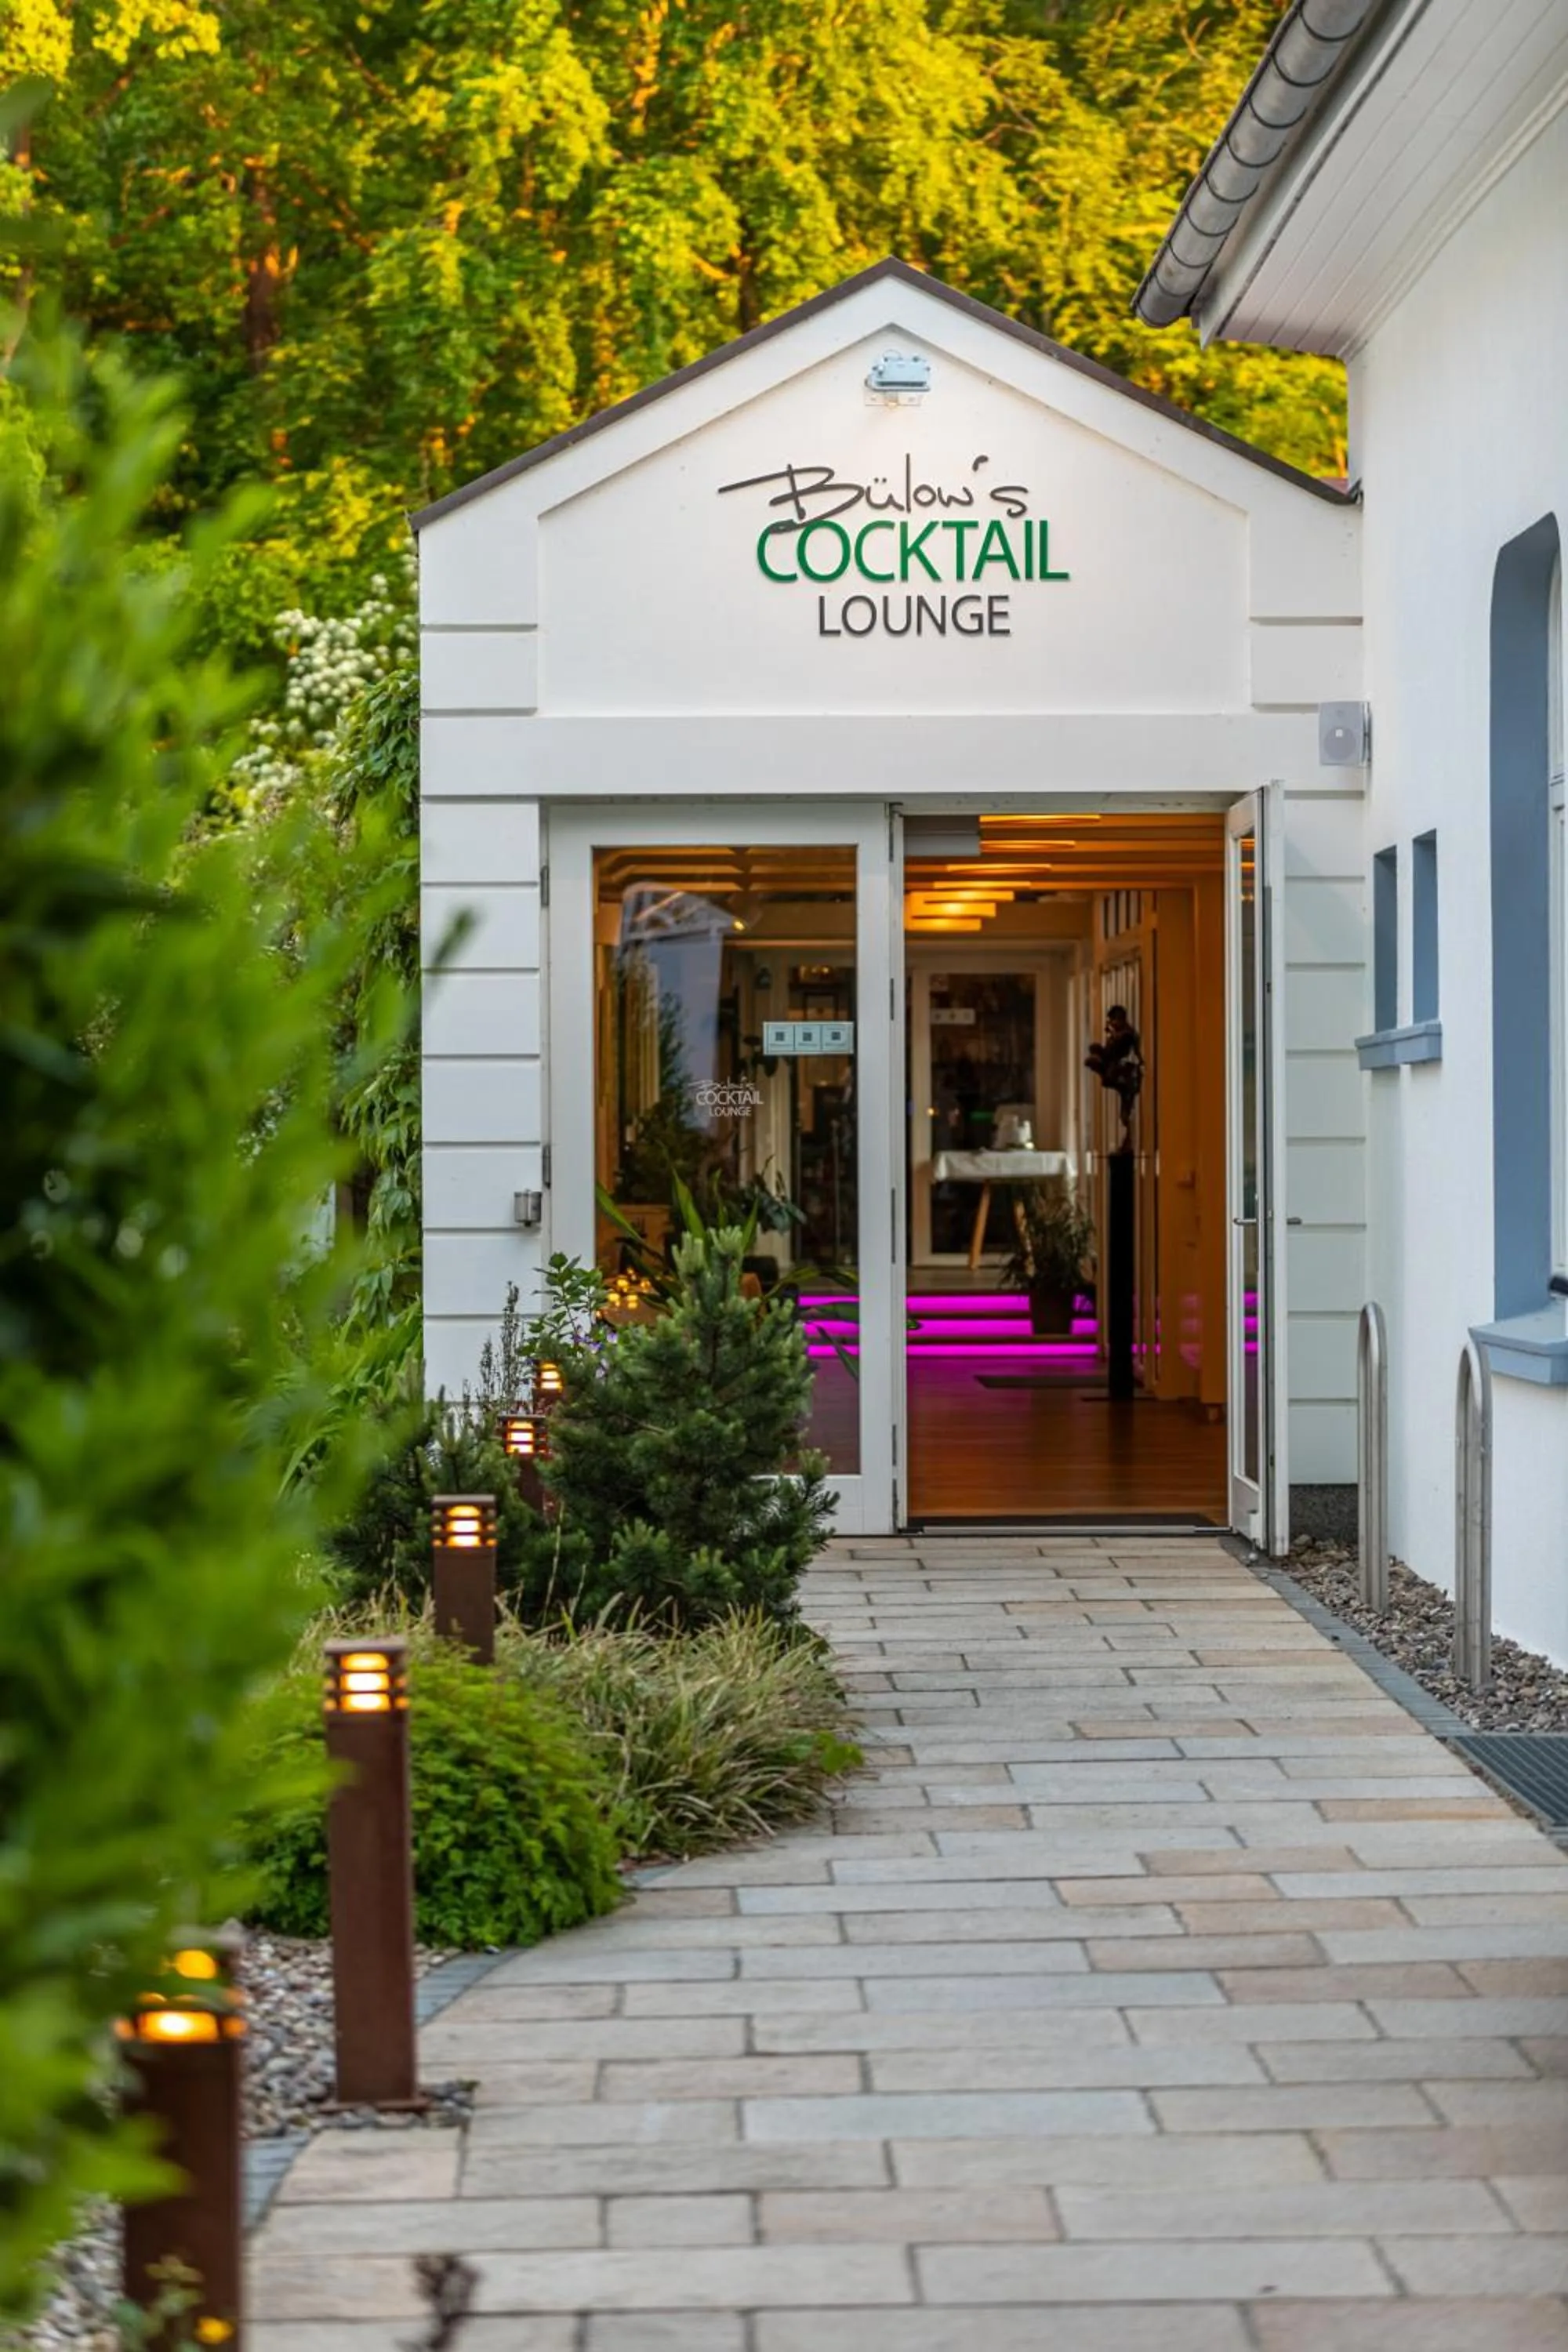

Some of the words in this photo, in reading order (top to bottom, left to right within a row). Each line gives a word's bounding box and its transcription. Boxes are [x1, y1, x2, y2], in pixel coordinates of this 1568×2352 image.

[757, 519, 1069, 583] COCKTAIL
[818, 594, 1011, 637] LOUNGE
[695, 1090, 764, 1105] COCKTAIL
[709, 1106, 752, 1116] LOUNGE
